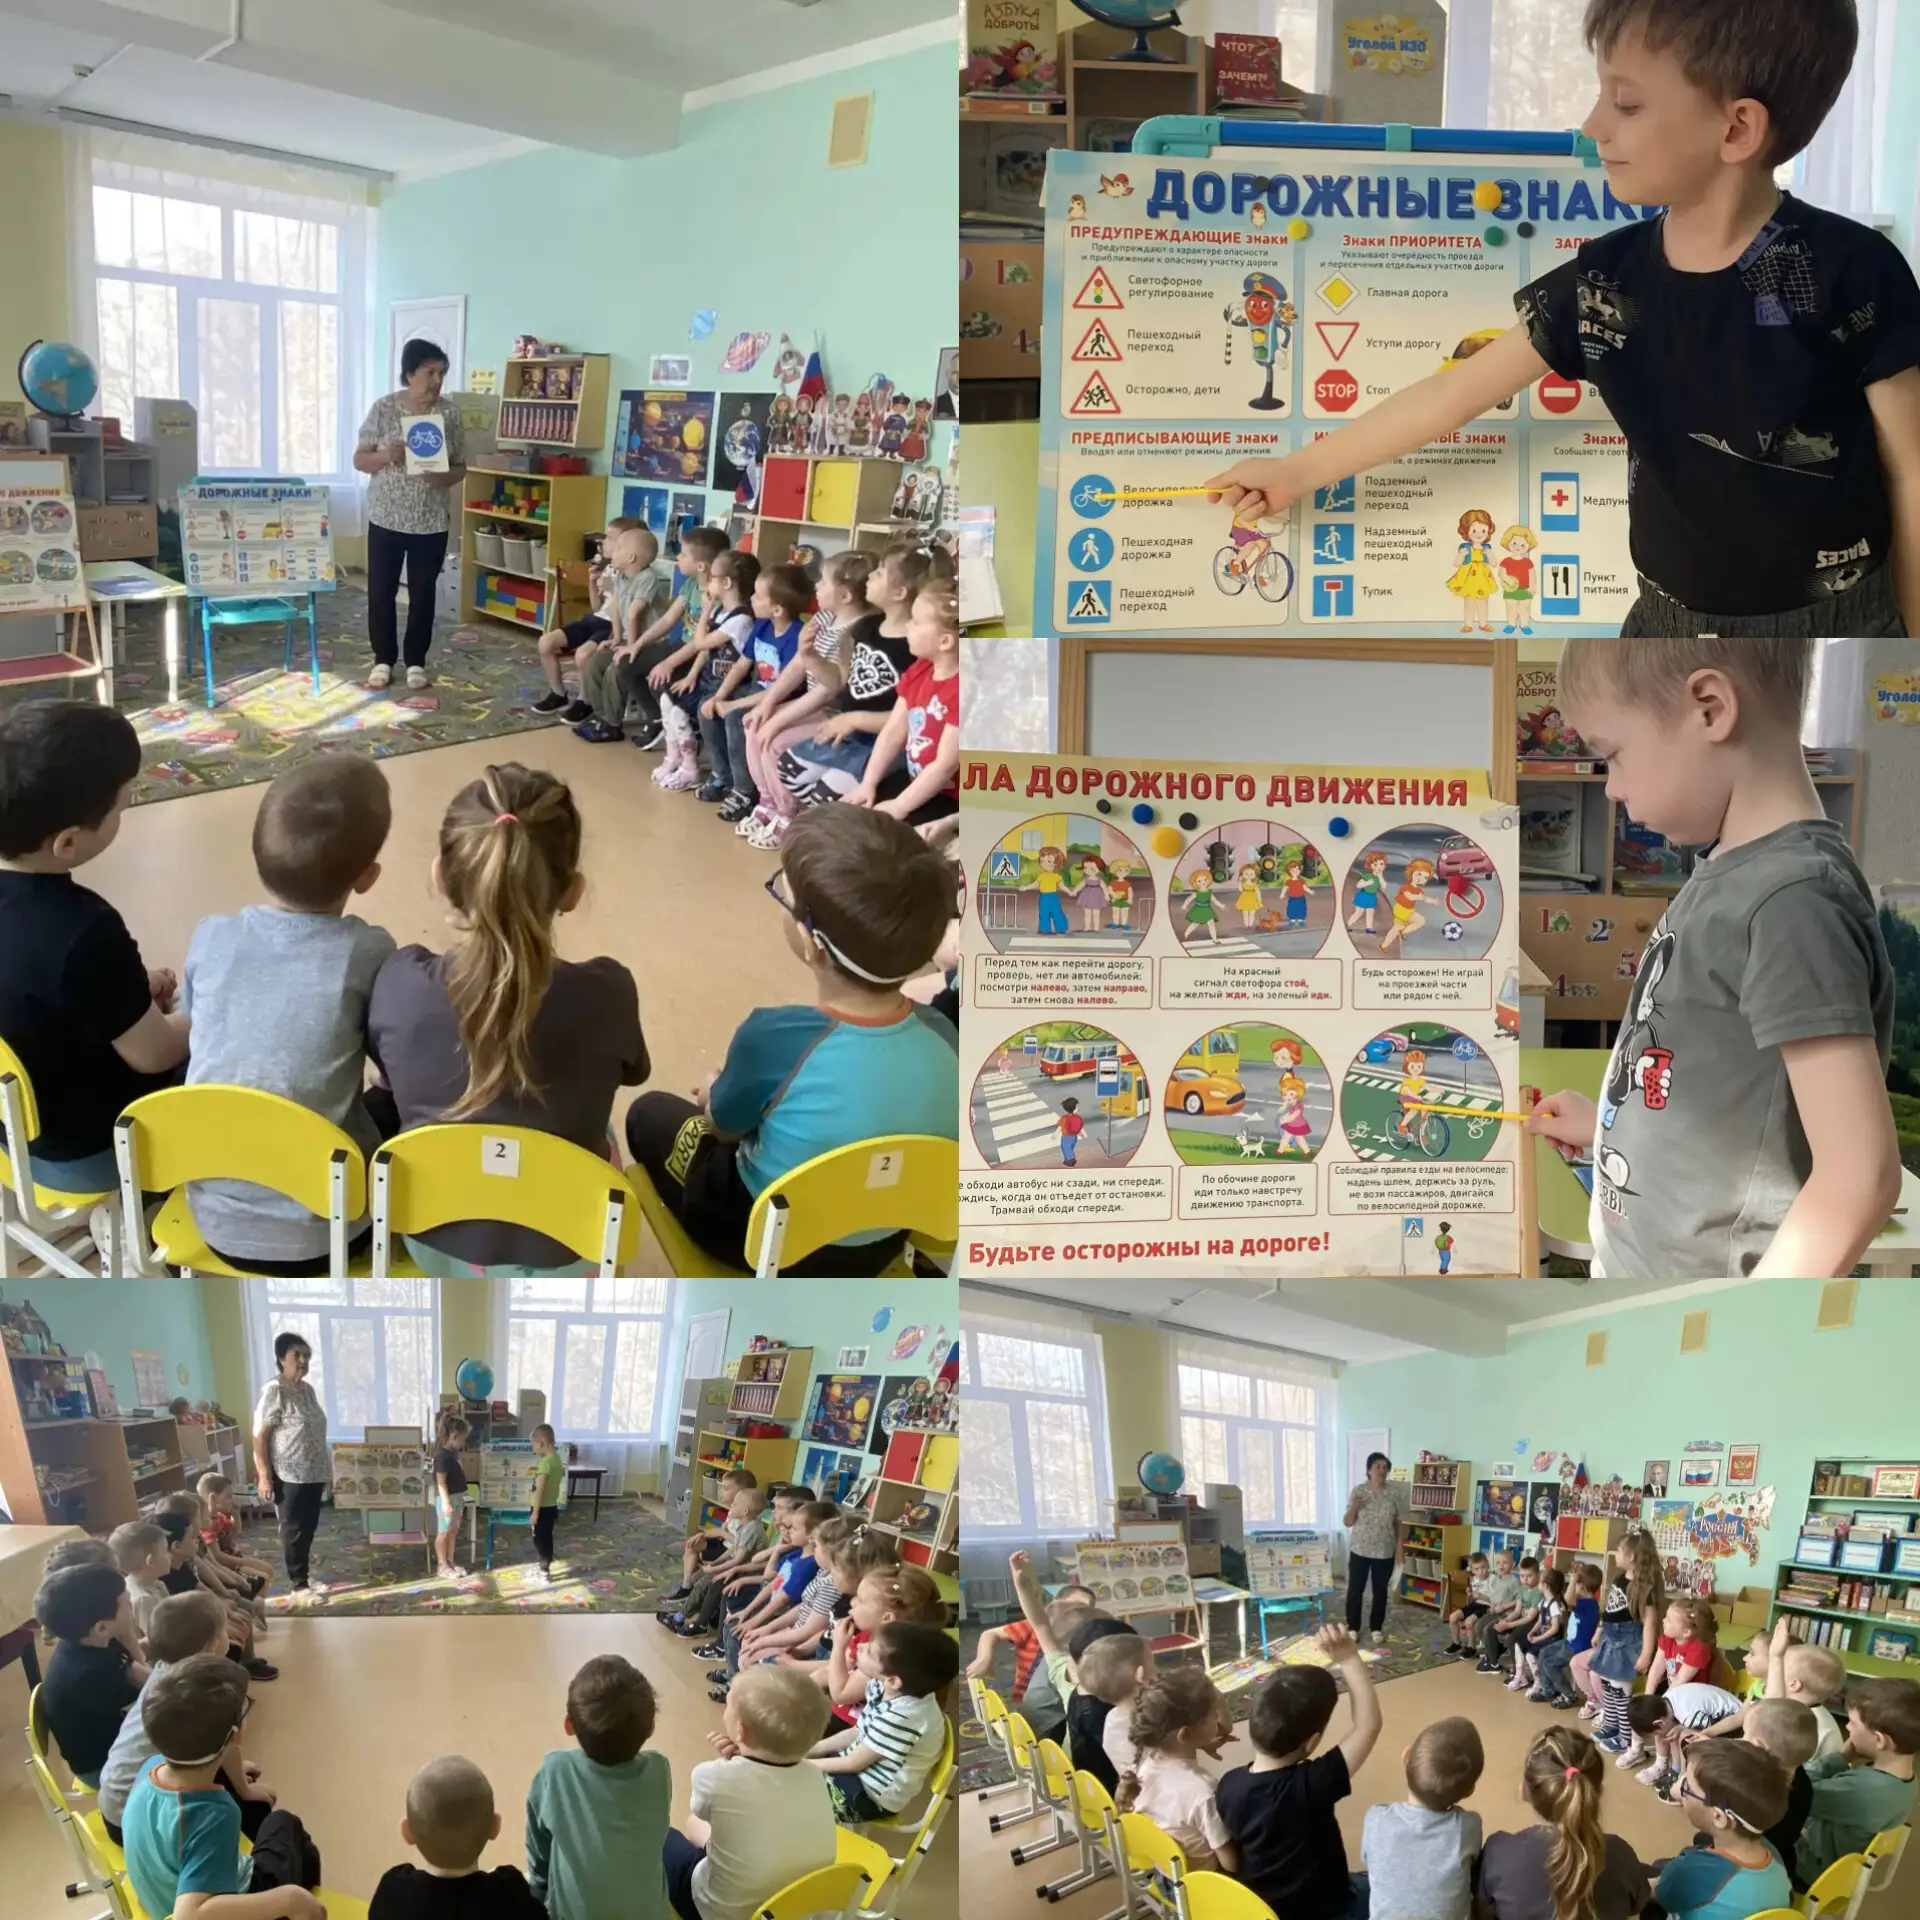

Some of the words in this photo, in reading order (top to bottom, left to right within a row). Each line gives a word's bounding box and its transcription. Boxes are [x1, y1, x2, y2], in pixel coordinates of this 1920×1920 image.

[985, 19, 1039, 30] ДОБРОТЫ
[1222, 41, 1254, 52] ЧТО?
[1146, 168, 1476, 221] ДОРОЖНЫЕ
[1492, 177, 1669, 221] ЗНАК
[1071, 226, 1242, 245] ПРЕДУПРЕЖДАЮЩИЕ
[1246, 233, 1288, 245] знаки
[1343, 235, 1386, 247] Знаки
[1389, 236, 1482, 249] ПРИОРИТЕТА
[1092, 242, 1166, 255] Предупреждают
[1176, 248, 1221, 258] характере
[1223, 249, 1268, 258] опасности
[1341, 250, 1389, 261] Указывают
[1391, 252, 1445, 261] очередность
[1448, 253, 1483, 262] проезда
[1089, 255, 1155, 266] приближении
[1164, 258, 1207, 267] опасному
[1209, 259, 1244, 267] участку
[1247, 259, 1278, 267] дороги
[1327, 261, 1383, 270] пересечения
[1386, 262, 1432, 270] отдельных
[1434, 262, 1472, 271] участков
[1474, 263, 1504, 271] дороги
[1129, 275, 1203, 288] Светофорное
[1129, 289, 1214, 300] регулирование
[1368, 288, 1409, 297] Главная
[1412, 288, 1448, 299] дорога
[1127, 329, 1201, 341] Пешеходный
[1127, 342, 1173, 353] переход
[1367, 338, 1403, 349] Уступи
[1406, 339, 1441, 350] дорогу
[1126, 385, 1190, 396] Осторожно,
[1194, 386, 1220, 395] дети
[1317, 384, 1356, 398] STOP
[1366, 386, 1390, 395] Стоп
[1072, 432, 1231, 445] ПРЕДПИСЫВАЮЩИЕ
[1236, 433, 1278, 444] знаки
[1465, 433, 1505, 444] знаки
[1583, 432, 1625, 445] Знаки
[1081, 447, 1114, 456] Вводят
[1185, 448, 1222, 456] режимы
[1225, 447, 1271, 455] движения
[1554, 447, 1598, 456] Сообщают
[1414, 457, 1451, 466] режимах
[1453, 457, 1496, 466] движения
[1365, 476, 1427, 488] Подземный
[198, 487, 268, 499] ДОРОЖНЫЕ
[271, 487, 312, 498] ЗНАКИ
[1365, 489, 1433, 500] пешеходный
[1123, 497, 1173, 508] дорожка
[1365, 501, 1409, 512] переход
[1365, 527, 1426, 538] Надземный
[1122, 536, 1193, 548] Пешеходная
[1364, 539, 1432, 551] пешеходный
[1121, 549, 1171, 561] дорожка
[1364, 551, 1408, 562] переход
[1584, 572, 1616, 584] Пункт
[1120, 587, 1194, 599] Пешеходный
[1362, 587, 1393, 597] Тупик
[1584, 585, 1628, 596] питания
[1120, 600, 1166, 612] переход
[1516, 671, 1556, 690] АЗБУК
[1516, 688, 1556, 697] ДОБРОТ
[1878, 690, 1920, 702] Уголо
[963, 763, 1015, 792] ЛА
[1026, 765, 1256, 801] ДОРОЖНОГО
[1266, 775, 1468, 807] ДВИЖЕНИЯ
[1592, 918, 1609, 942] 2
[985, 958, 1017, 970] Перед
[1021, 959, 1038, 968] тем
[1041, 959, 1059, 968] как
[1063, 959, 1105, 969] перейти
[1108, 960, 1144, 971] дорогу,
[1621, 952, 1638, 977] 5
[987, 972, 1032, 982] проверь,
[1036, 972, 1053, 980] нет
[1071, 971, 1142, 981] автомобилей:
[1239, 967, 1281, 978] красный
[1362, 967, 1384, 978] Будь
[1386, 969, 1439, 979] осторожен!
[1457, 969, 1484, 979] играй
[980, 984, 1028, 993] посмотри
[1031, 984, 1069, 994] налево,
[1073, 984, 1101, 993] затем
[1104, 984, 1147, 994] направо,
[1194, 979, 1228, 988] сигнал
[1230, 979, 1281, 990] светофора
[1284, 978, 1309, 989] стой,
[1393, 979, 1438, 990] проезжей
[1440, 981, 1467, 989] части
[1554, 974, 1568, 997] 4
[1011, 996, 1041, 1005] затем
[1044, 996, 1074, 1005] снова
[1077, 996, 1118, 1005] налево.
[1184, 990, 1223, 1000] желтый
[1225, 991, 1250, 1001] жди,
[1266, 990, 1308, 1000] зеленый
[1311, 992, 1332, 1000] иди.
[1383, 992, 1401, 1000] или
[1403, 992, 1433, 1002] рядом
[1442, 992, 1462, 1000] ней.
[495, 1143, 506, 1159] 2
[880, 1157, 892, 1171] 2
[1335, 1166, 1378, 1176] Соблюдай
[1381, 1167, 1416, 1176] правила
[1418, 1167, 1440, 1175] езды
[1456, 1166, 1509, 1175] велосипеде:
[967, 1181, 1004, 1190] обходи
[1007, 1179, 1048, 1190] автобус
[1066, 1180, 1100, 1189] сзади,
[1103, 1179, 1116, 1187] ни
[1118, 1178, 1164, 1188] спереди.
[1217, 1175, 1258, 1184] обочине
[1261, 1174, 1295, 1186] дороги
[1347, 1178, 1380, 1187] надень
[1383, 1178, 1412, 1188] шлем,
[1415, 1178, 1457, 1188] держись
[1472, 1177, 1496, 1188] руль,
[1002, 1193, 1031, 1202] когда
[1034, 1193, 1047, 1201] он
[1050, 1191, 1094, 1201] отъедет
[1109, 1190, 1166, 1200] остановки.
[1194, 1188, 1213, 1197] иди
[1216, 1188, 1250, 1197] только
[1252, 1186, 1302, 1199] навстречу
[1364, 1191, 1385, 1199] вози
[1388, 1189, 1448, 1200] пассажиров,
[1450, 1189, 1494, 1199] двигайся
[991, 1204, 1034, 1216] Трамвай
[1038, 1204, 1074, 1214] обходи
[1077, 1203, 1124, 1214] спереди.
[1191, 1200, 1244, 1212] движению
[1246, 1199, 1305, 1210] транспорта.
[1371, 1201, 1440, 1211] велосипедной
[1442, 1201, 1486, 1211] дорожке.
[969, 1242, 1055, 1267] Будьте
[1063, 1240, 1199, 1262] осторожны
[1207, 1239, 1234, 1256] на
[1241, 1232, 1330, 1257] дороге!
